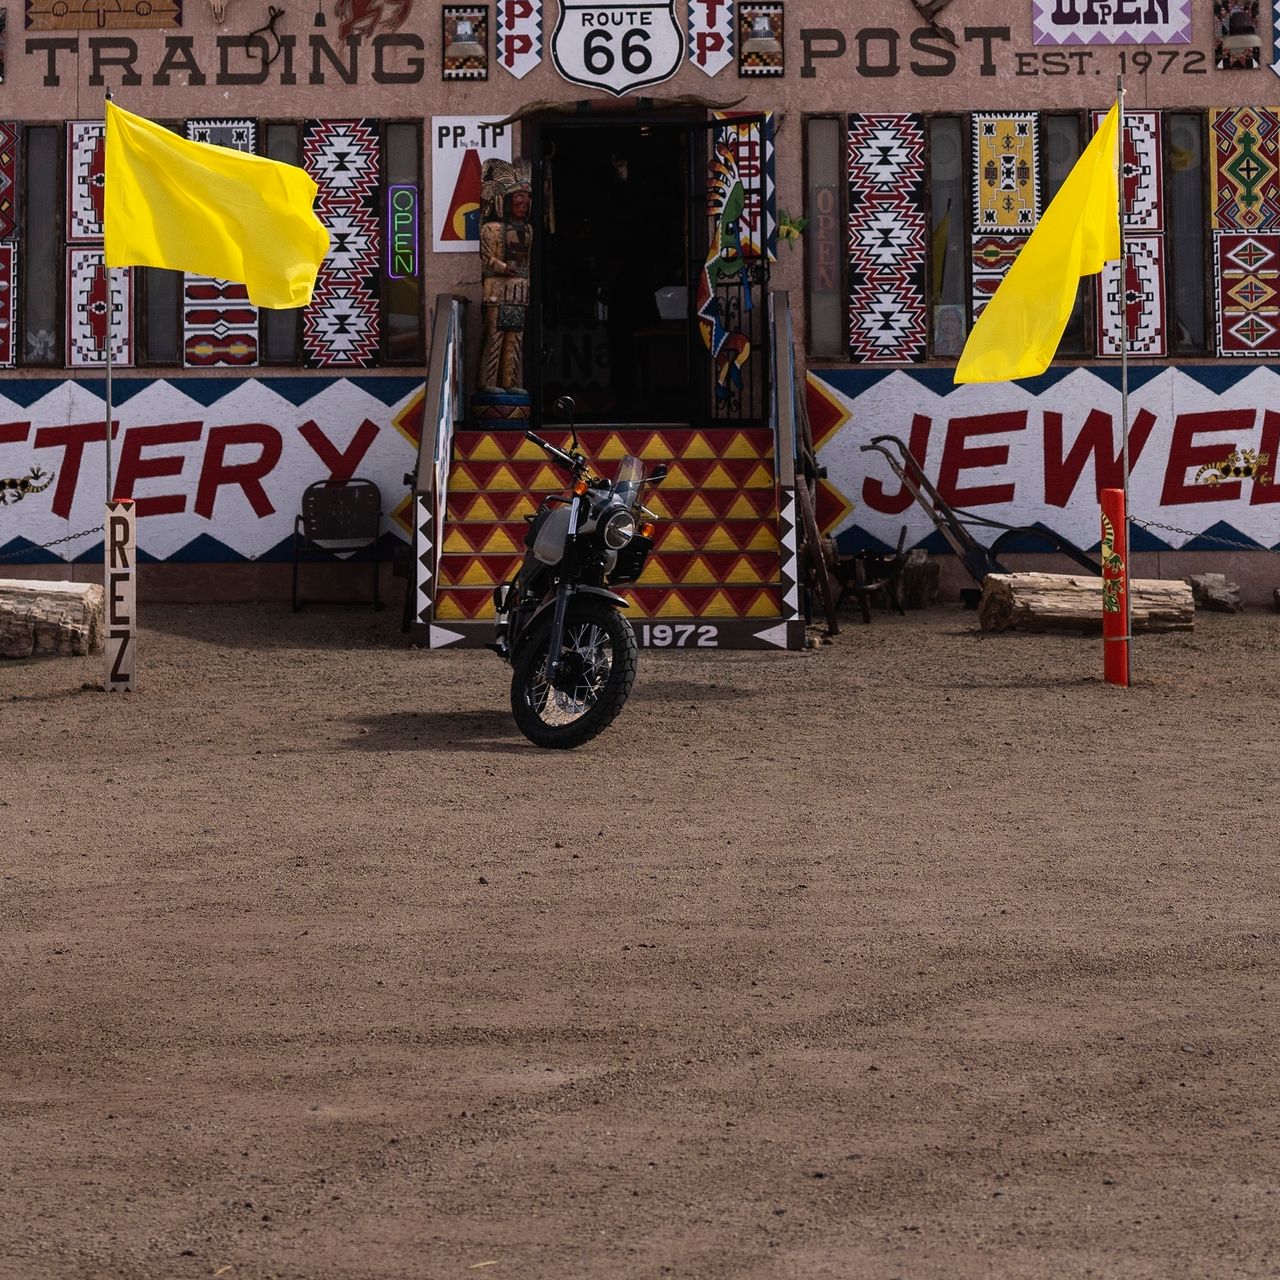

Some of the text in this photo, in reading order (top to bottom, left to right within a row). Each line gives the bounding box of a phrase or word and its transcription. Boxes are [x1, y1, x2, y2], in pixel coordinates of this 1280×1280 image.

[581, 11, 652, 27] ROUTE
[25, 26, 1207, 86] TRADING POST EST. 1972
[583, 28, 652, 75] 66
[438, 126, 466, 148] PP
[477, 124, 504, 148] TP
[393, 190, 413, 273] OPEN
[816, 188, 836, 291] OPEN
[109, 516, 130, 683] REZ
[642, 624, 719, 648] 1972
